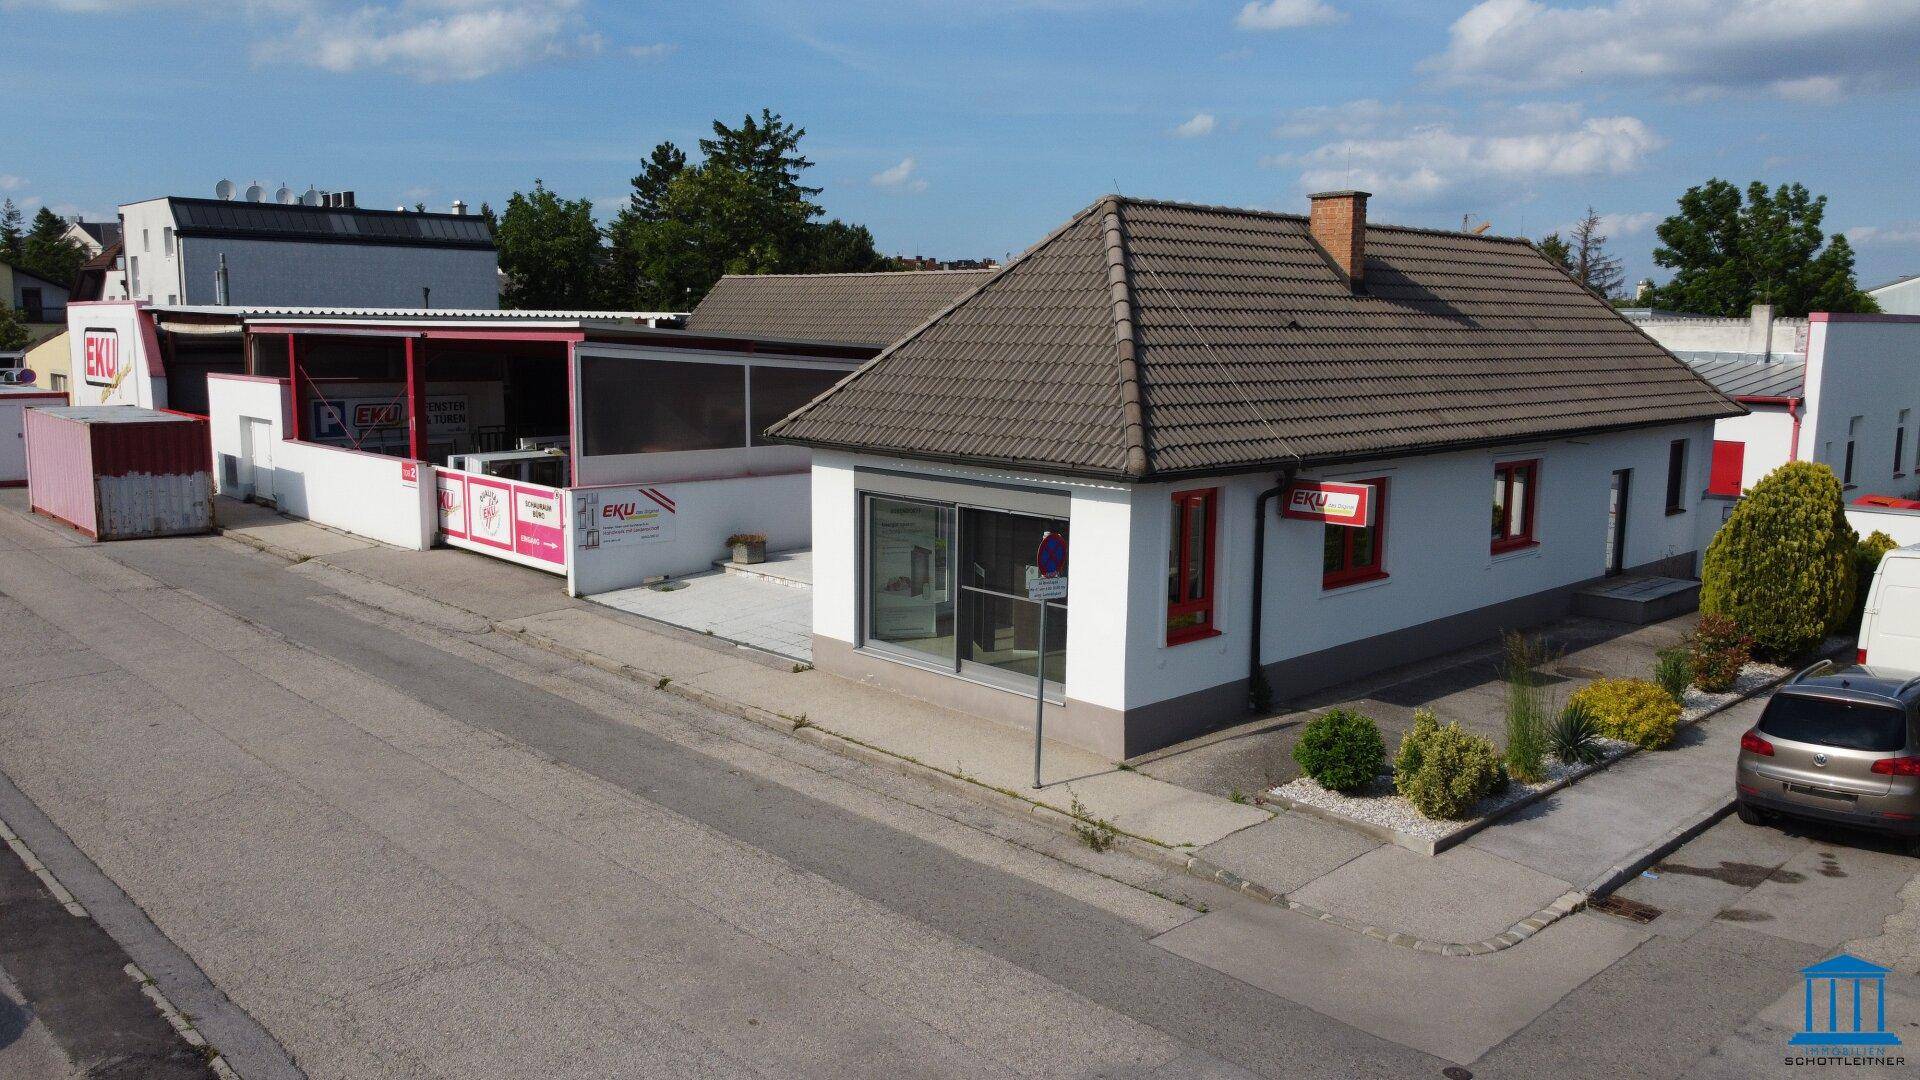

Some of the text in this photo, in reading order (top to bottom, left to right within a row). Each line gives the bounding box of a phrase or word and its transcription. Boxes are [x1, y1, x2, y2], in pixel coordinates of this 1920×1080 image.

[86, 337, 116, 379] EKU
[426, 400, 465, 412] ENSTER
[320, 405, 342, 434] P
[356, 407, 398, 424] EKU
[411, 467, 417, 478] 2
[1292, 491, 1328, 511] EKU
[602, 502, 636, 520] EKU
